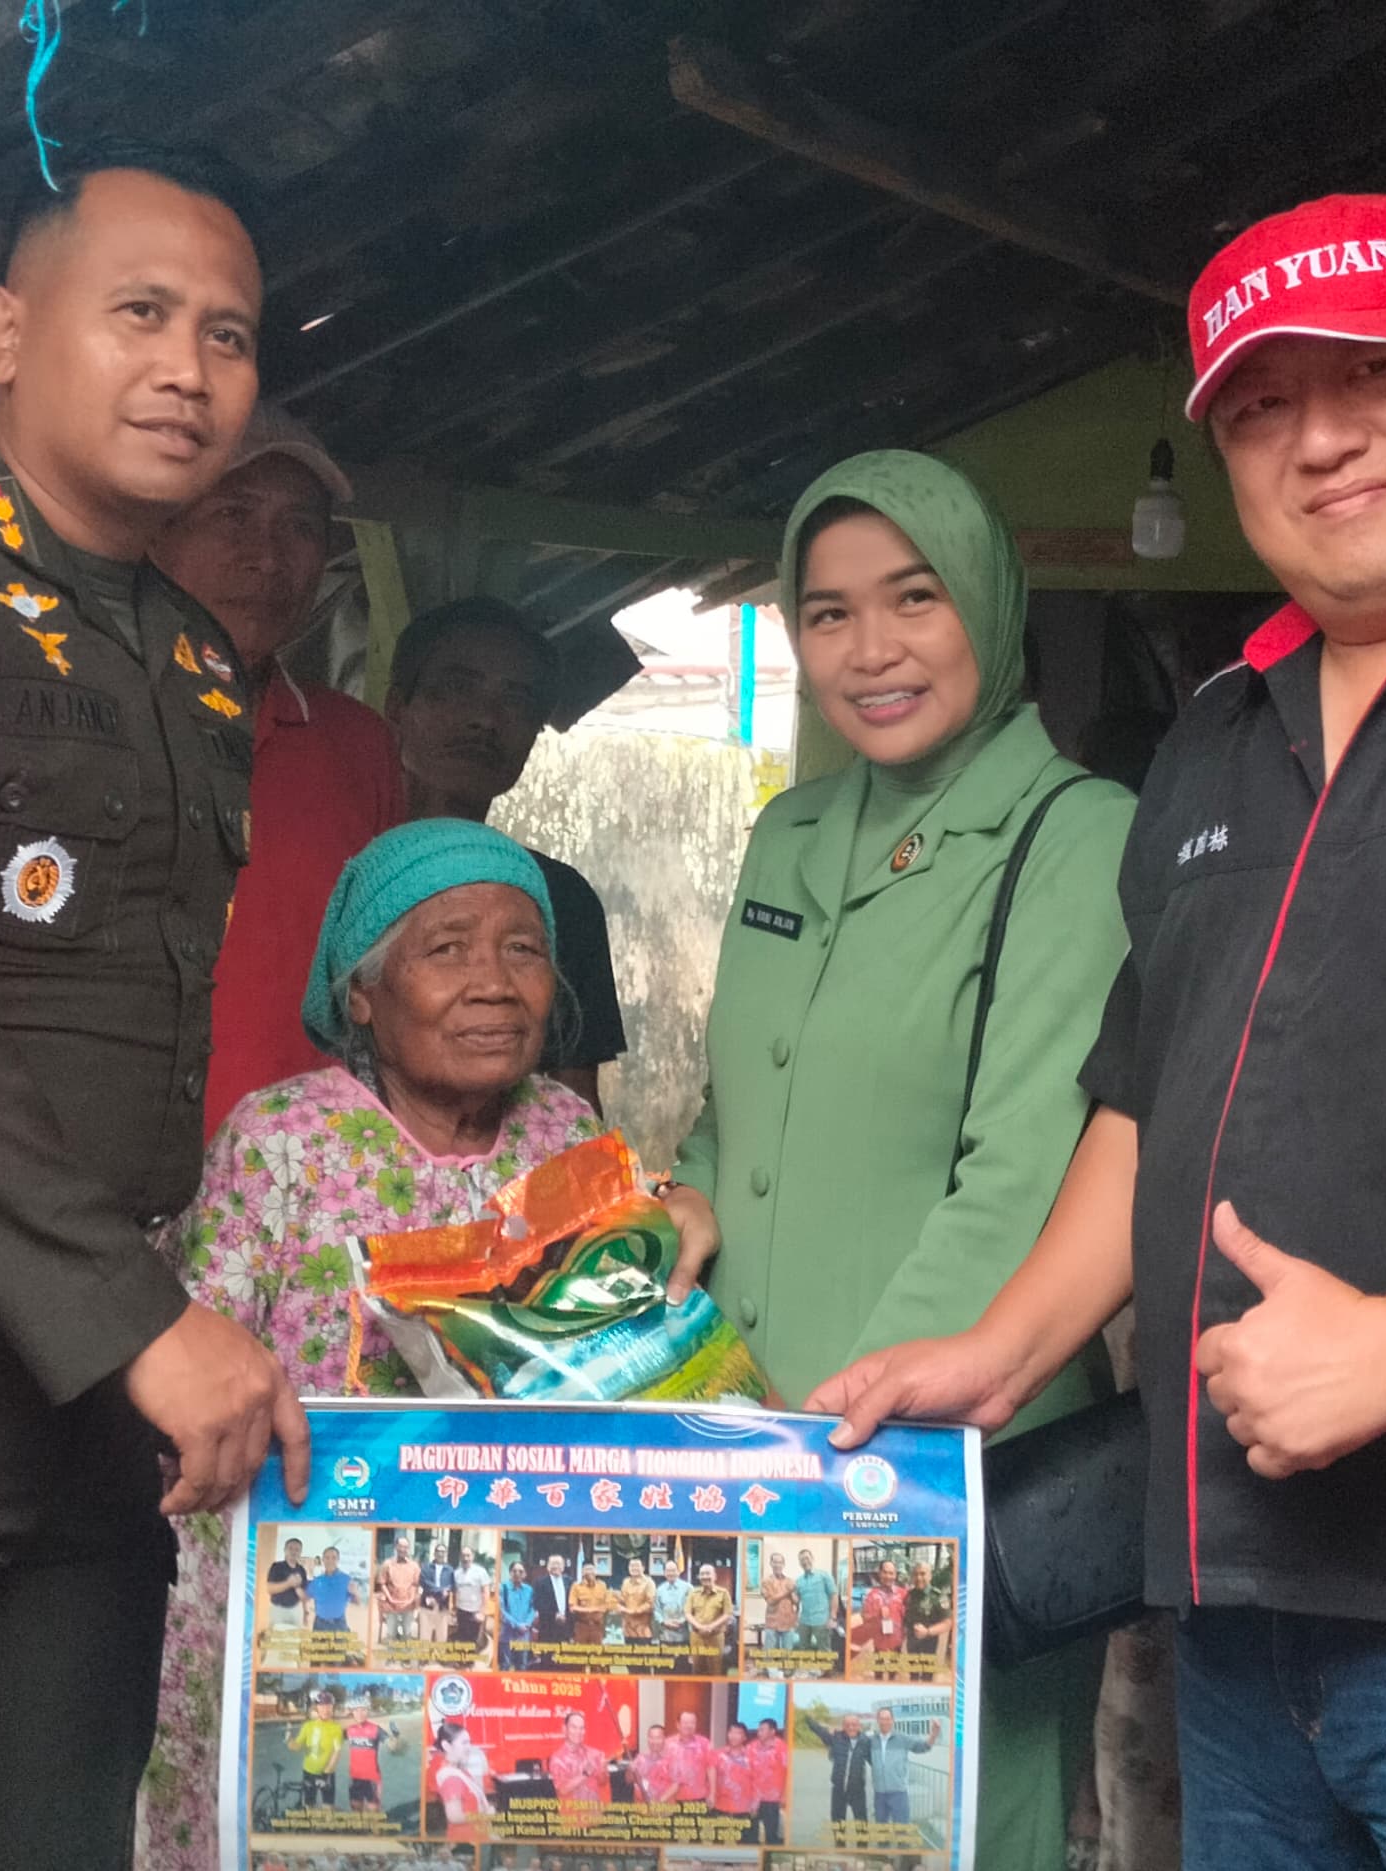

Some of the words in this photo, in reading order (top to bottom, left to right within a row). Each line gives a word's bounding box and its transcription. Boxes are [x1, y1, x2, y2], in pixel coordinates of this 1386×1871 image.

[1203, 266, 1271, 347] HAN
[399, 1445, 503, 1472] PAGUYUBAN
[506, 1446, 566, 1474] SOSIAL
[568, 1447, 632, 1476] MARGA
[729, 1452, 823, 1481] INDONESIA
[328, 1498, 376, 1511] PSMTI
[501, 1678, 547, 1695] Tahun
[551, 1682, 582, 1698] 2025
[509, 1798, 561, 1811] MUSPROV
[602, 1801, 648, 1814] Lampung
[682, 1802, 708, 1814] 2025
[507, 1812, 544, 1825] kepada
[628, 1815, 673, 1827] Chandra
[517, 1825, 546, 1836] Ketua
[547, 1825, 581, 1837] PSMTI
[583, 1827, 631, 1840] Lampung
[632, 1828, 673, 1839] Periode
